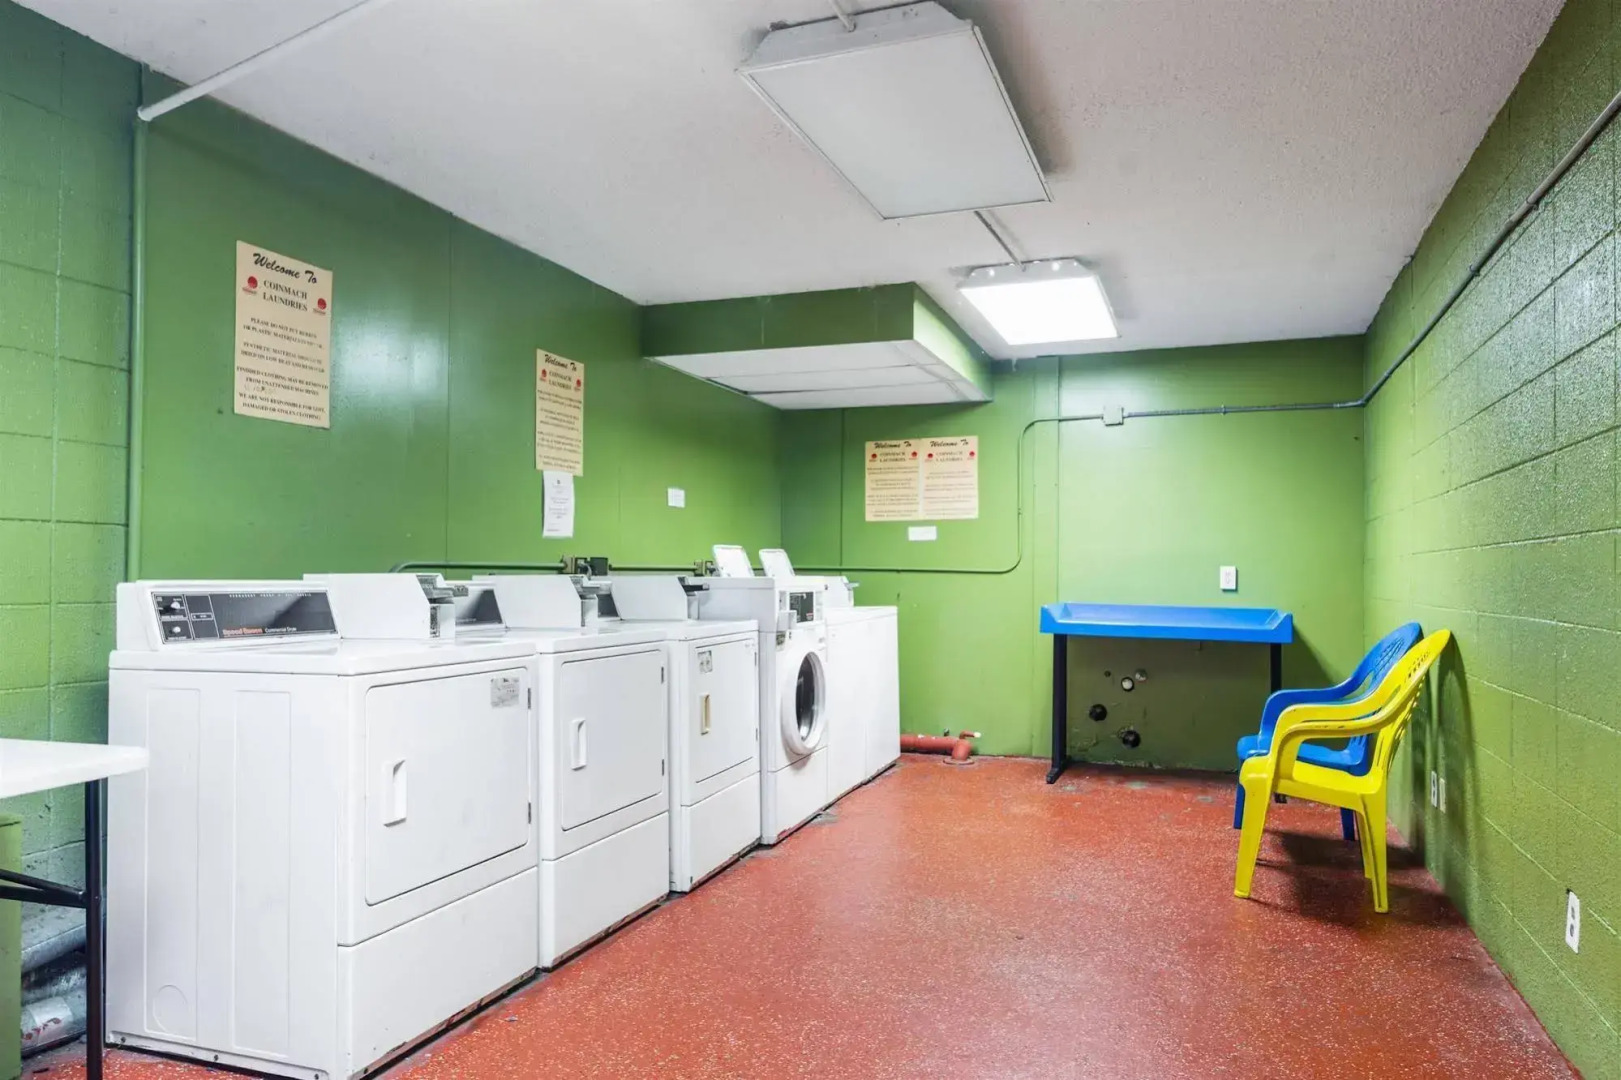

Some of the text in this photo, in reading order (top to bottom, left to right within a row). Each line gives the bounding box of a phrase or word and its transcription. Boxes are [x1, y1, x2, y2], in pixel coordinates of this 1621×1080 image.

[253, 252, 317, 284] Welcome To
[264, 280, 308, 300] COINMACH
[264, 292, 308, 311] LAUNDRIES
[251, 317, 269, 327] PLEASE
